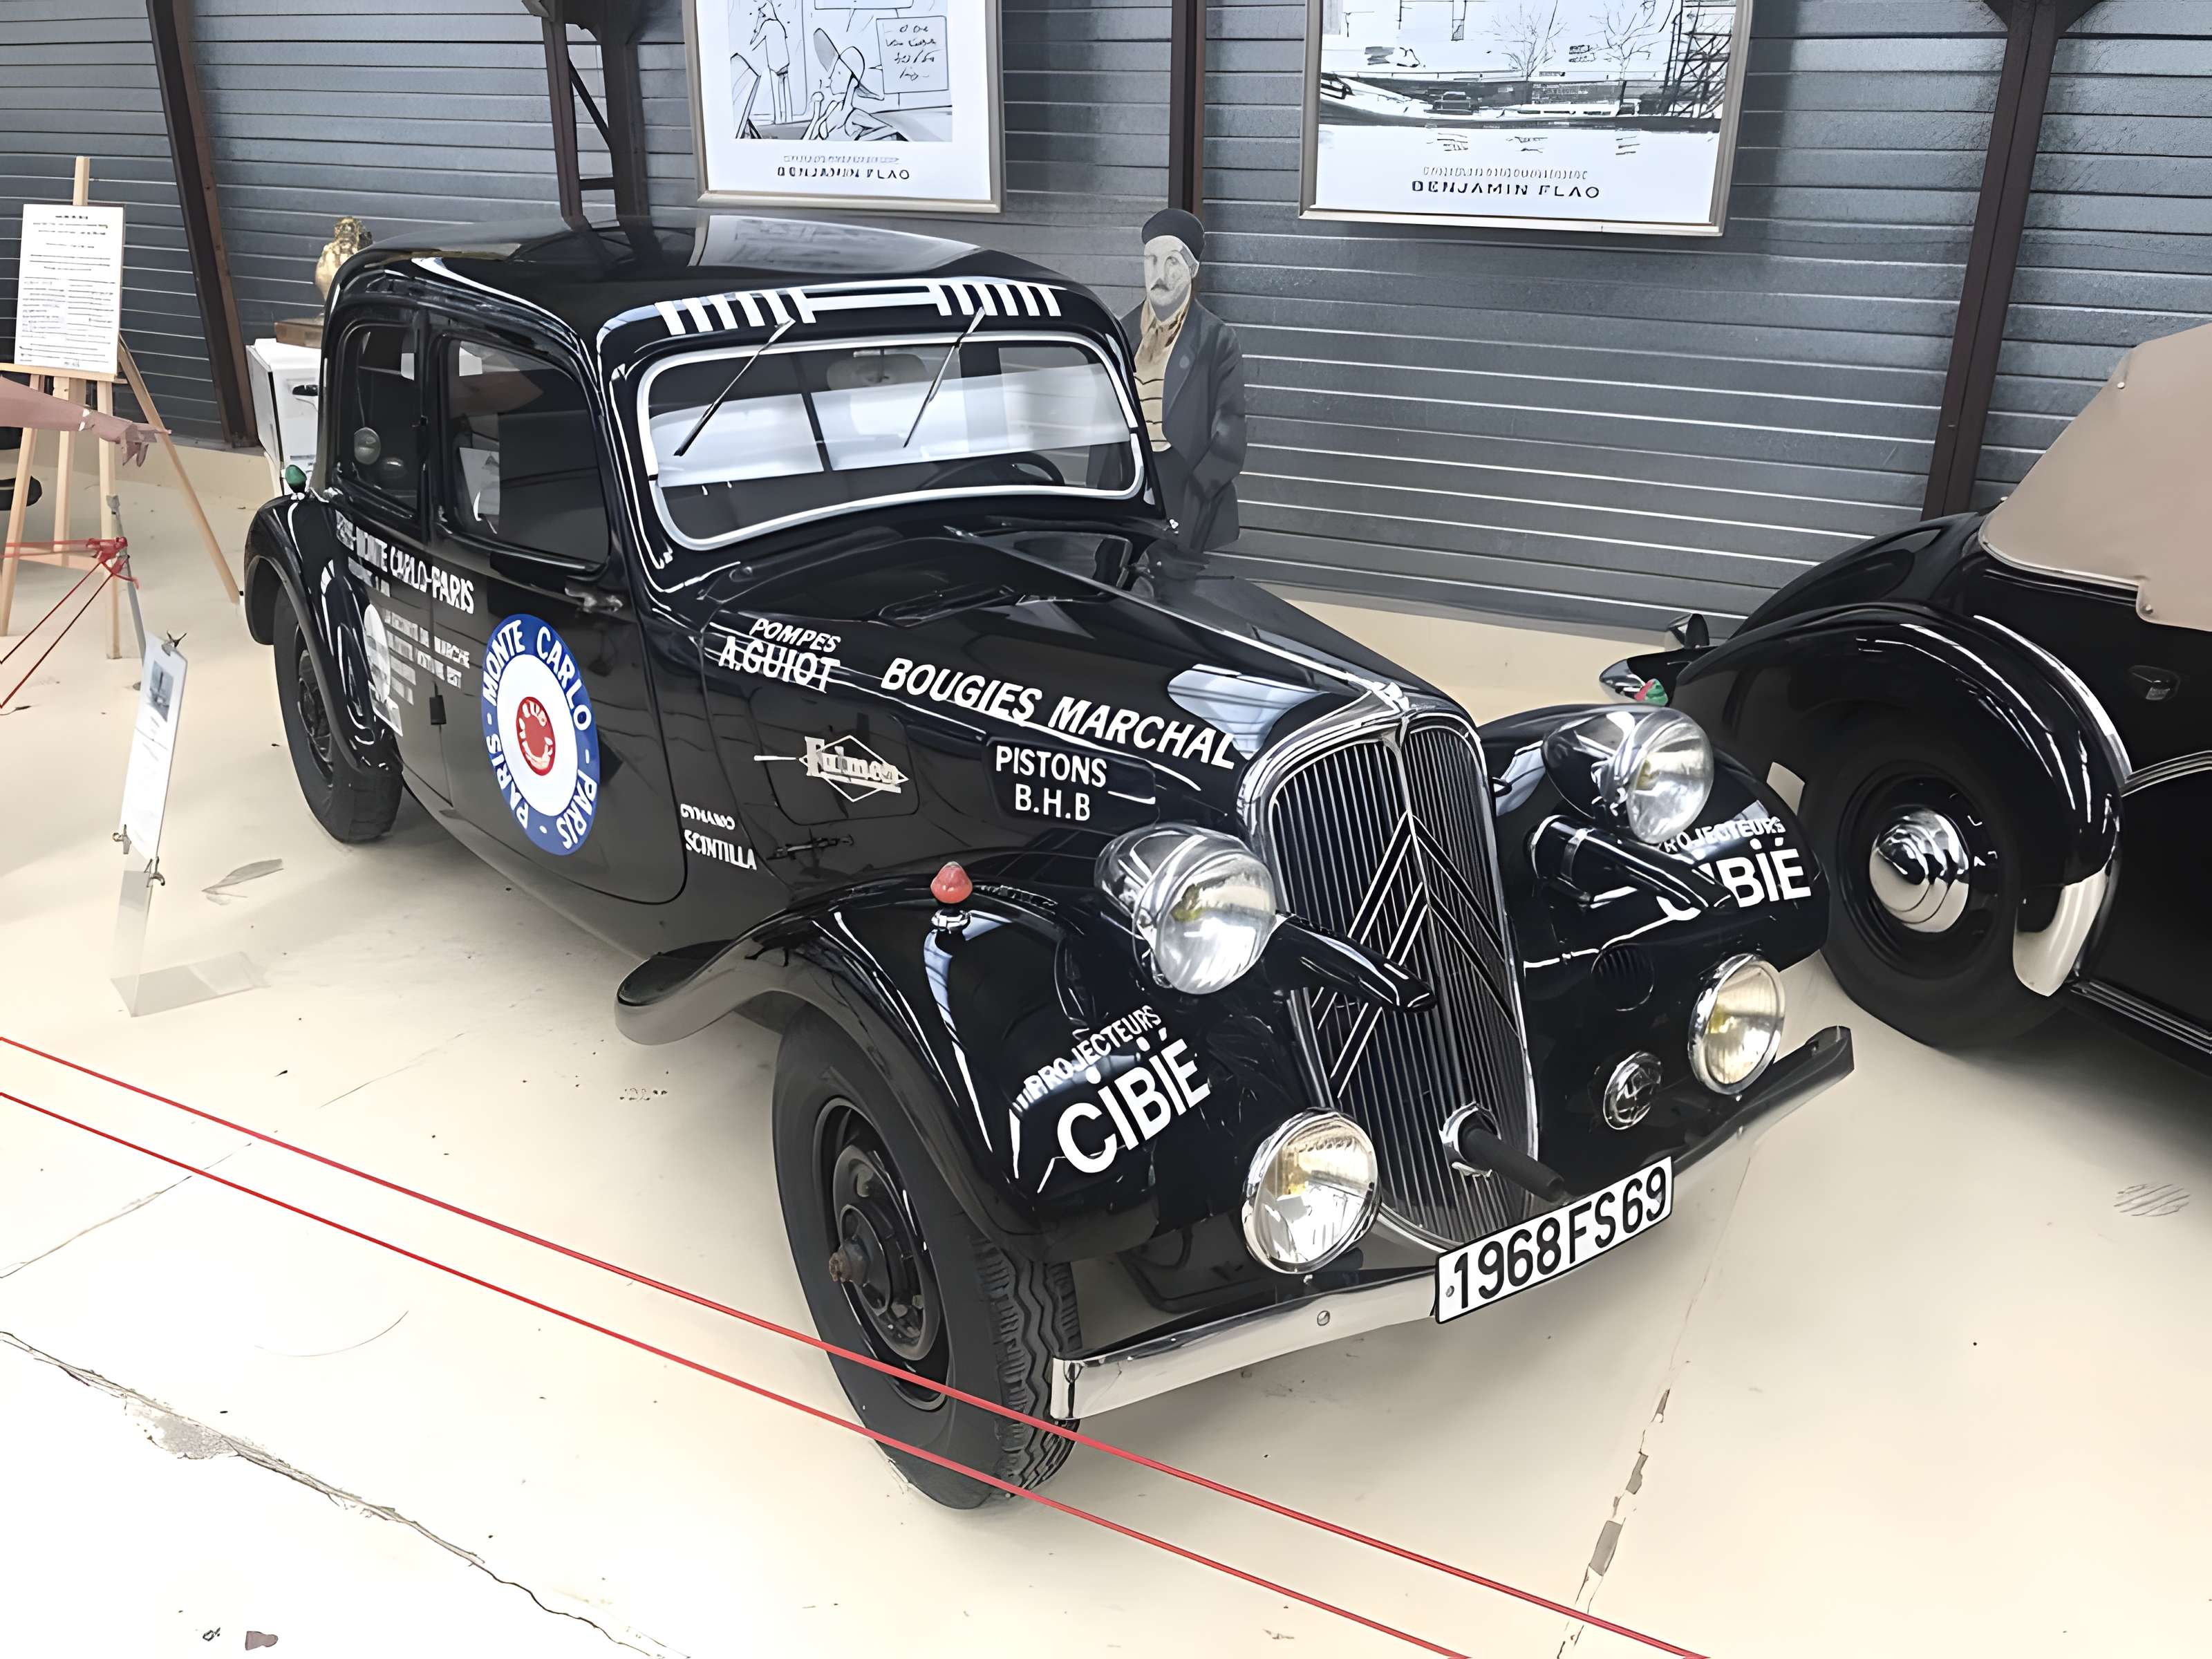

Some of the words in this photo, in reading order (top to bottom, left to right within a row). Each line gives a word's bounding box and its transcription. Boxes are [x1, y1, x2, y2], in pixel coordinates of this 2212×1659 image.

[1539, 184, 1600, 198] FLAO
[482, 619, 525, 705] MONTE
[749, 617, 841, 653] POMPES
[536, 626, 592, 731] CARLO
[881, 657, 1043, 727] BOUGIES
[1047, 695, 1236, 769] MARCHAL
[487, 735, 530, 830] PARIS
[995, 745, 1107, 788] PISTONS
[560, 769, 597, 850] PARIS
[1015, 783, 1091, 822] B.H.B
[684, 829, 758, 871] SCINTILLA
[1659, 816, 1786, 853] ROJECTEURS
[1023, 1004, 1162, 1101] PROJECTEURS
